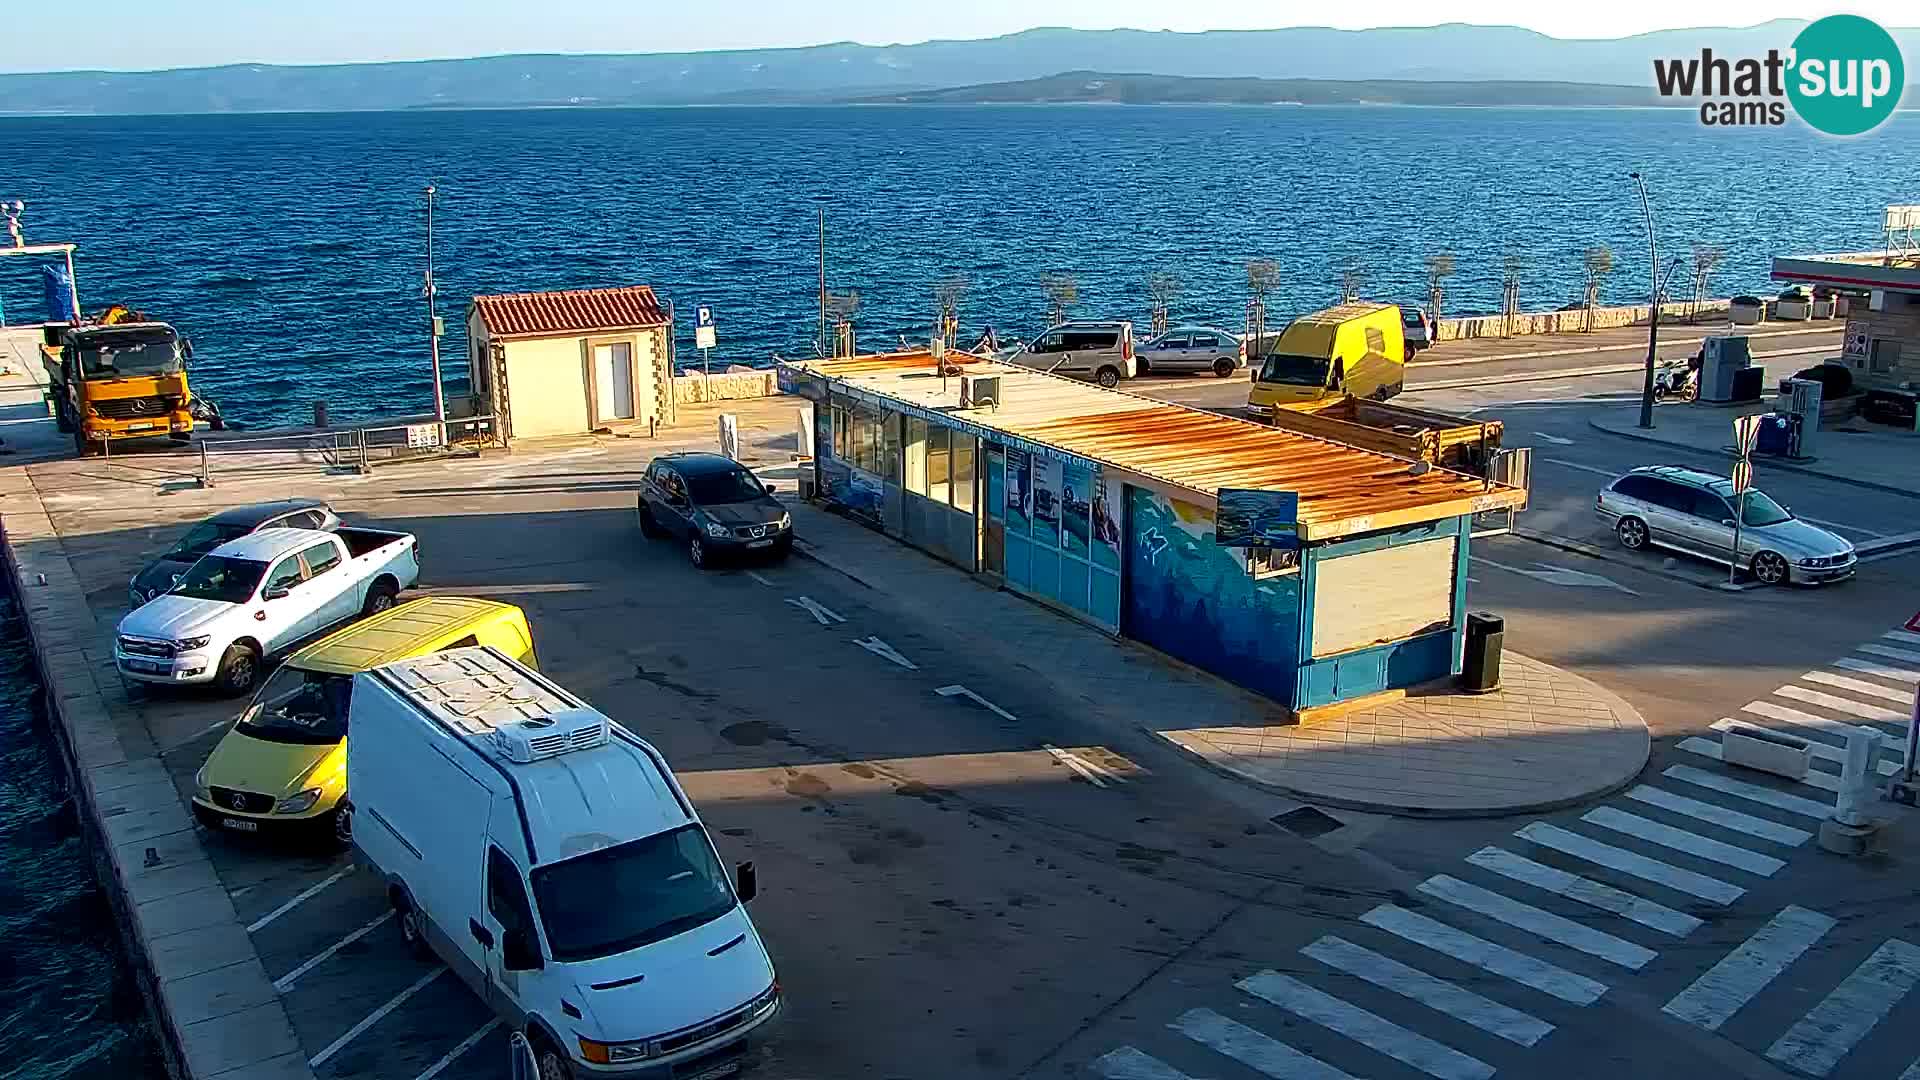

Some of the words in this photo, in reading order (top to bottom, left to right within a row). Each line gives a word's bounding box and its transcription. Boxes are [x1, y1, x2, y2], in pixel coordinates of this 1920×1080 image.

[699, 308, 710, 326] P
[1001, 434, 1015, 449] BUS
[1016, 438, 1046, 456] STATION
[1048, 448, 1072, 465] TICKET
[1073, 457, 1097, 472] OFFICE
